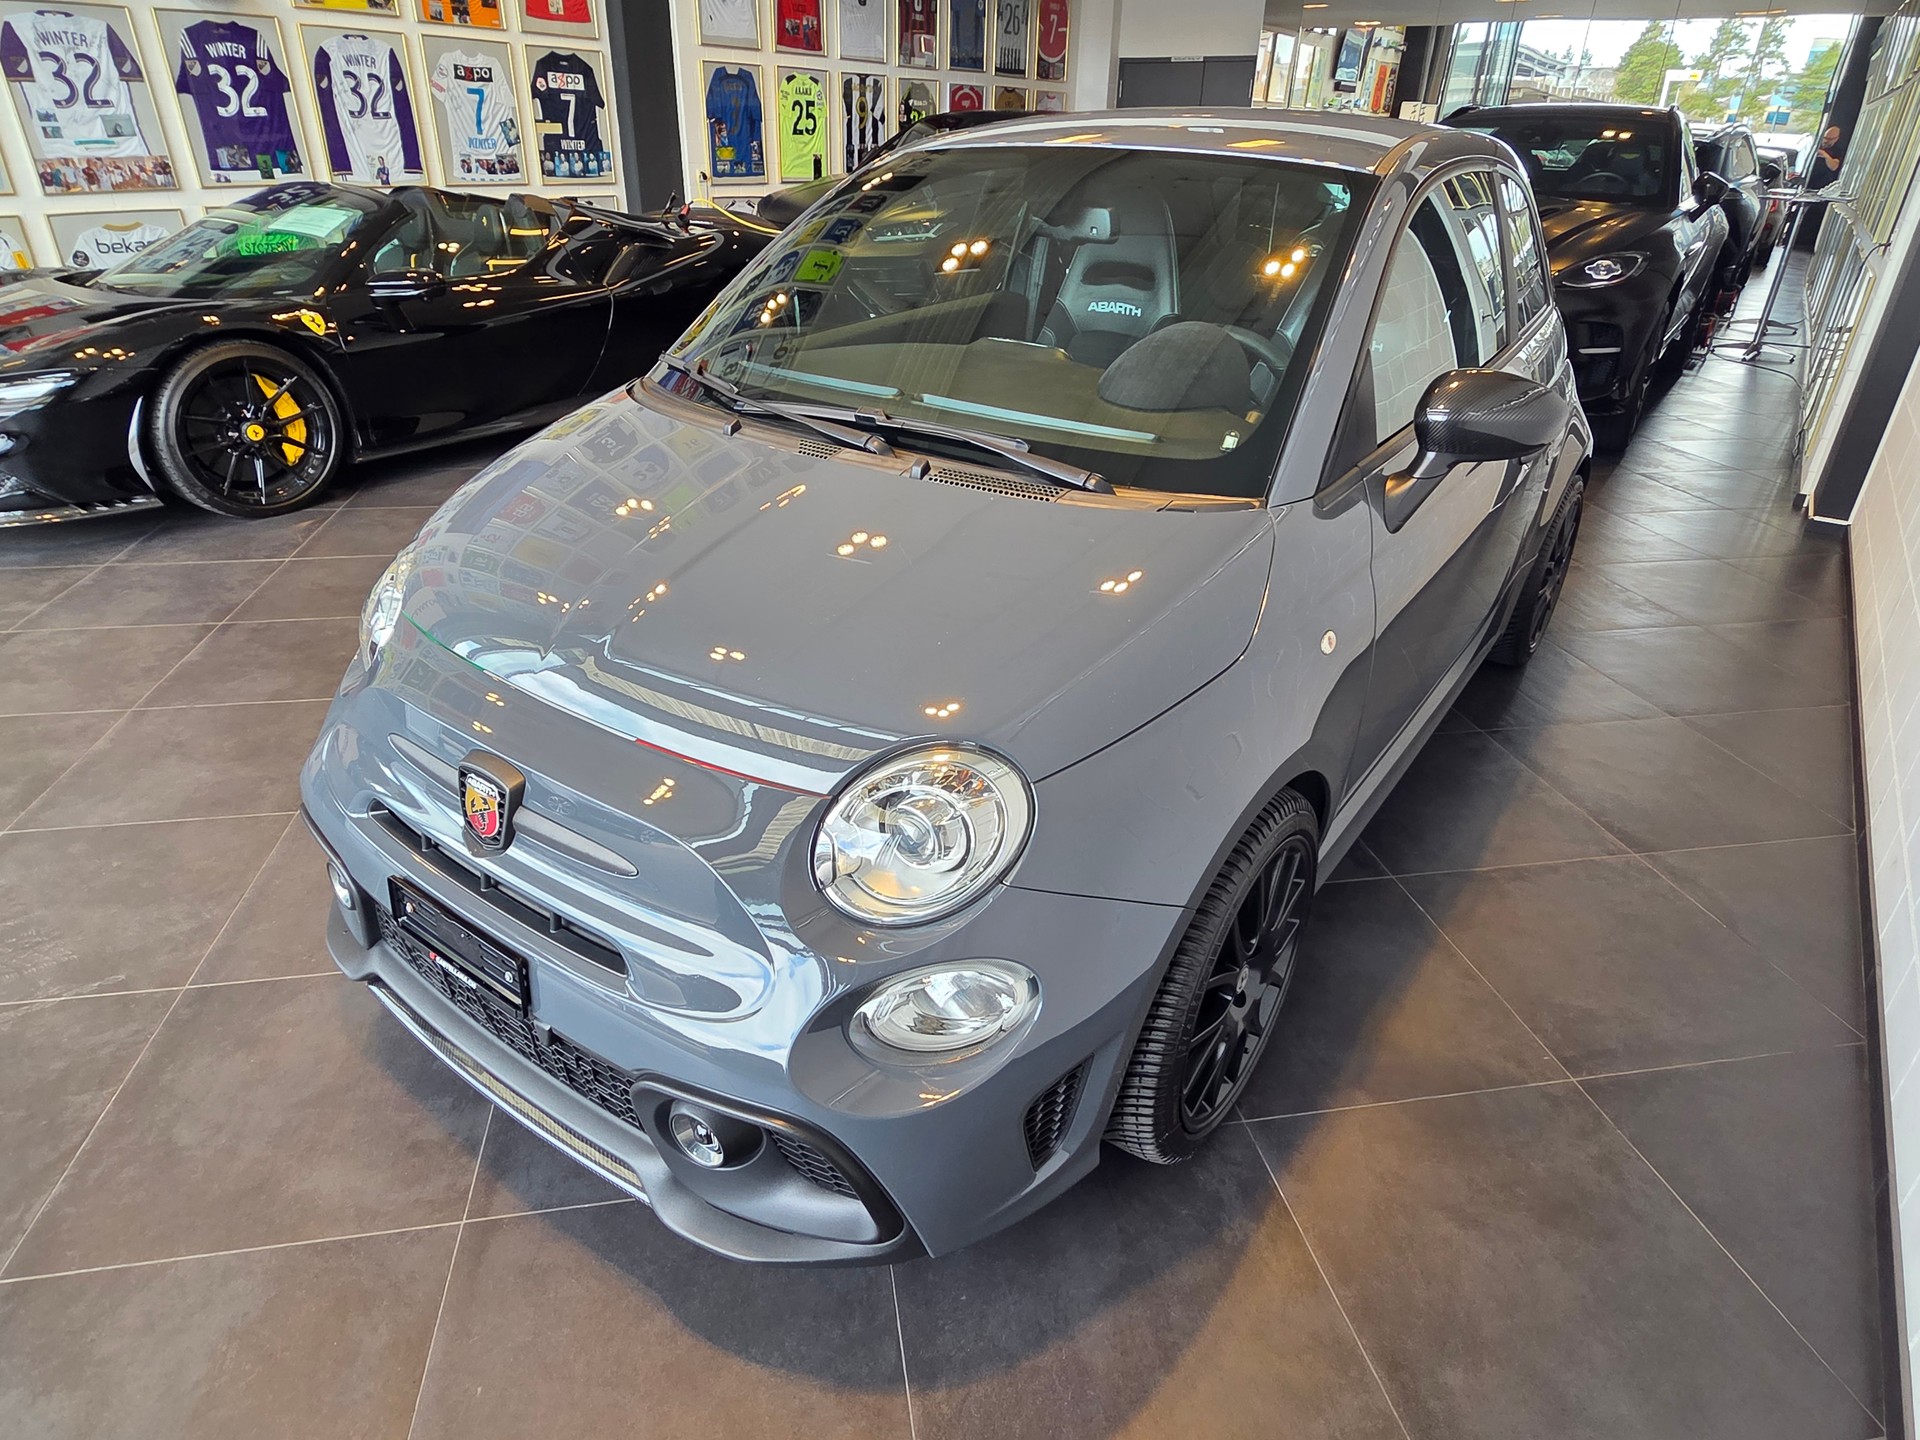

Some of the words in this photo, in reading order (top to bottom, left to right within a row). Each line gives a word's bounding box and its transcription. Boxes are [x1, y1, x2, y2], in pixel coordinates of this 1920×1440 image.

[1004, 3, 1020, 35] 26
[36, 30, 88, 48] WINTER
[205, 42, 247, 59] WINTER
[342, 54, 377, 69] WINTER
[38, 51, 115, 109] 32
[207, 63, 269, 118] 32
[343, 70, 392, 120] 32
[467, 87, 485, 135] 7
[560, 93, 576, 138] 7
[791, 99, 817, 136] 25
[855, 96, 869, 129] 9
[1087, 301, 1142, 317] ABARTH
[467, 776, 496, 798] ABARTH
